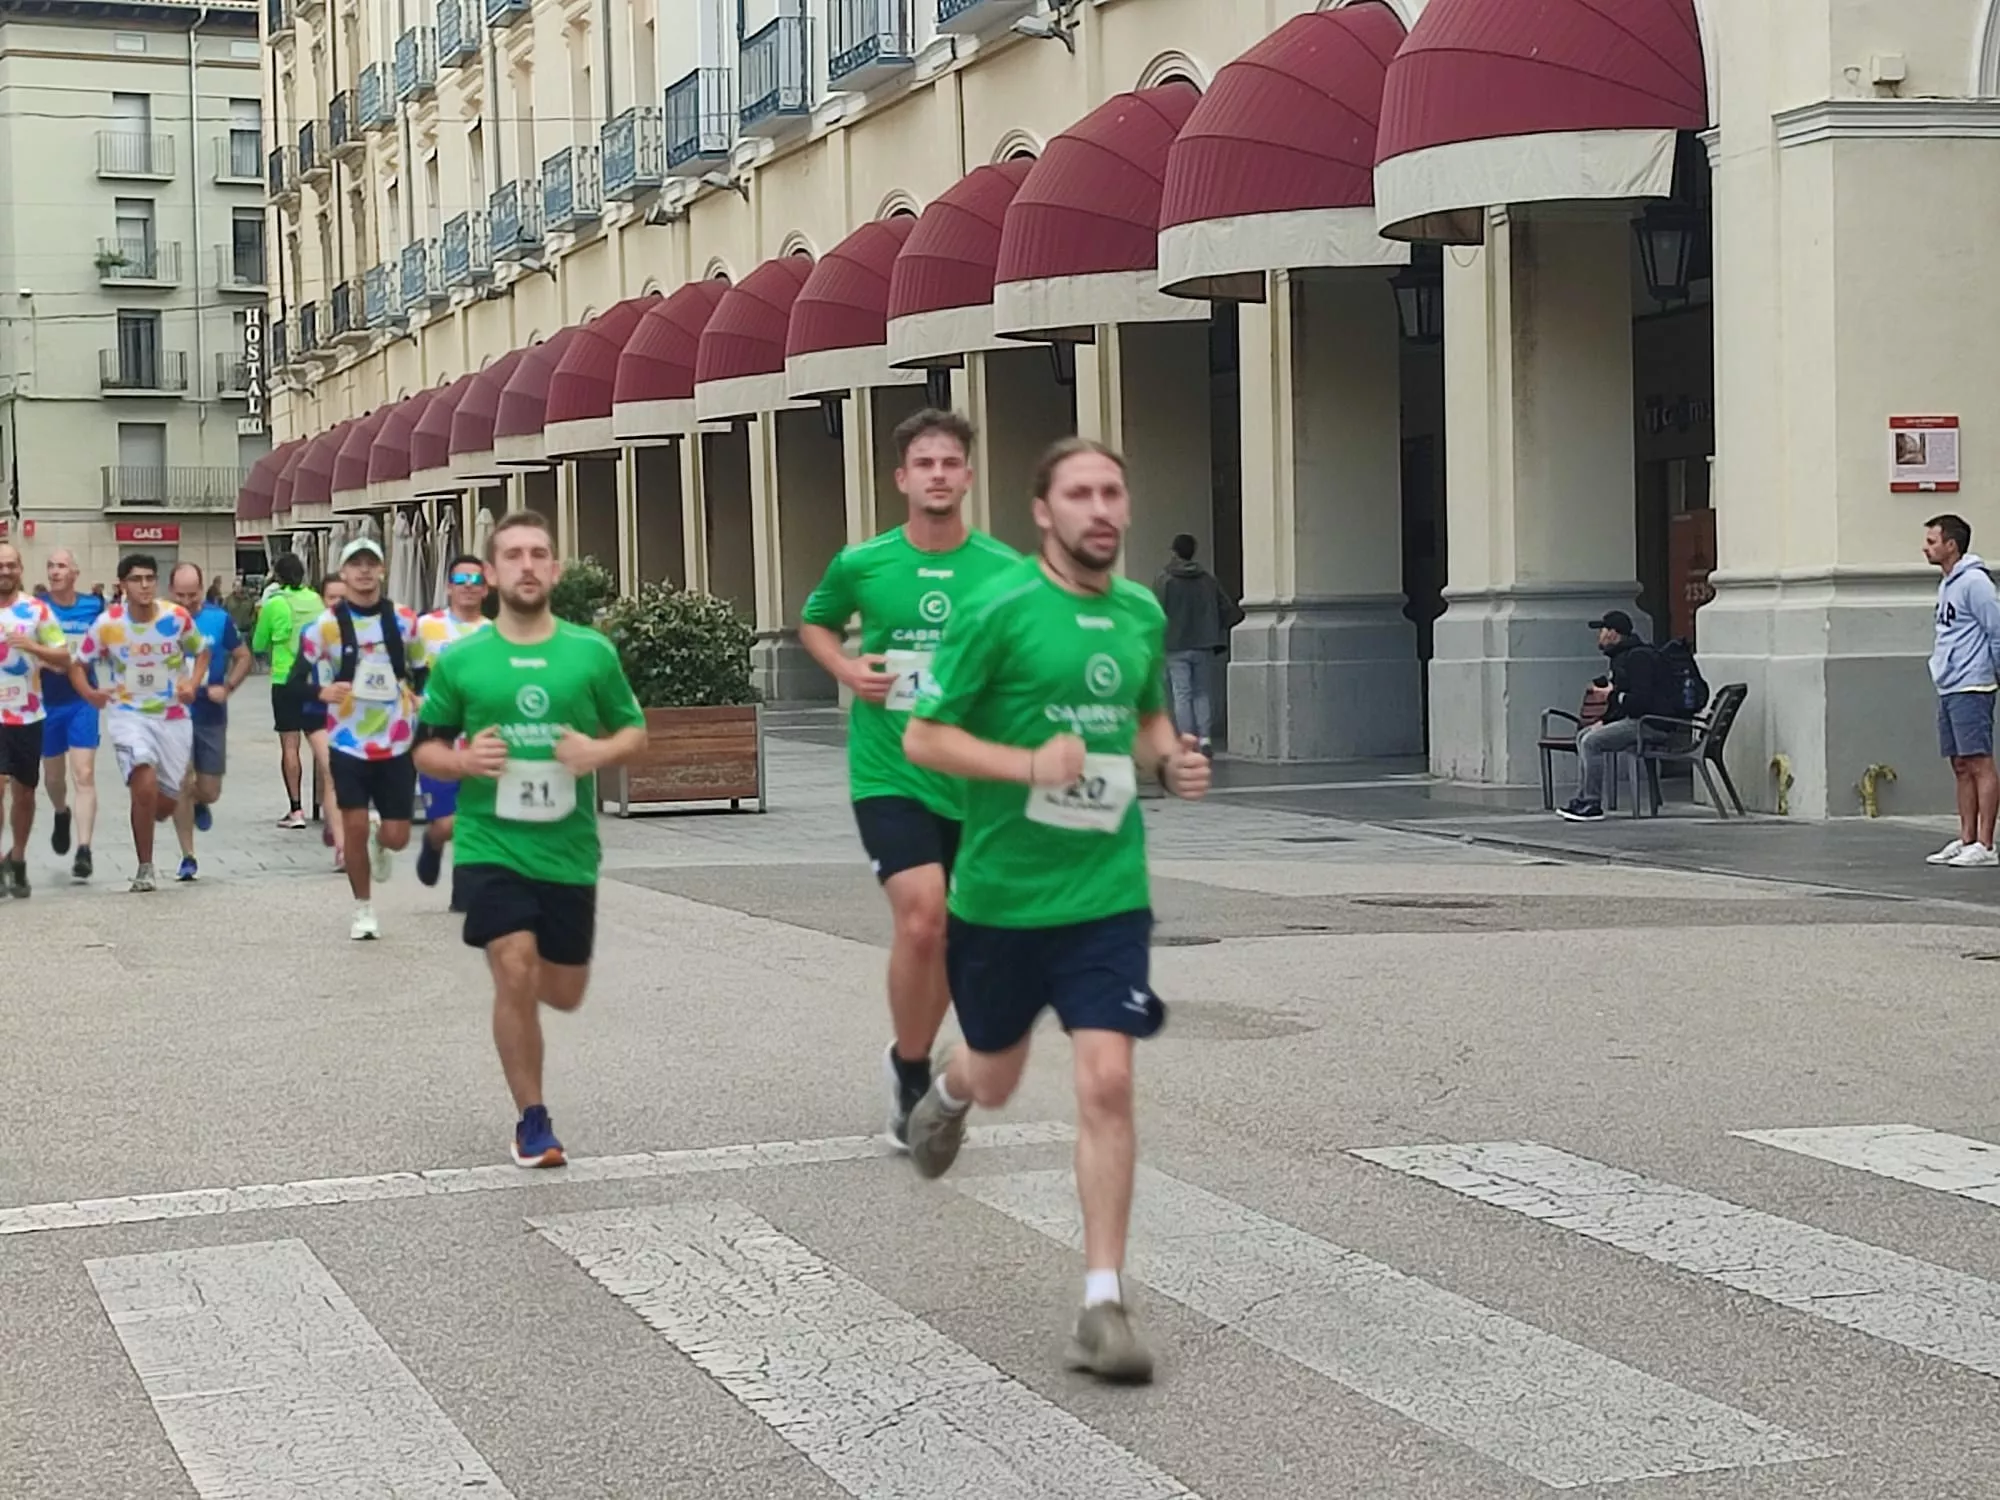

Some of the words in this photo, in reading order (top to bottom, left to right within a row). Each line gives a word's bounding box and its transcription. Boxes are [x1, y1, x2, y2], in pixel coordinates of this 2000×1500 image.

[245, 307, 262, 414] HOSTAL
[132, 527, 163, 539] GAES
[519, 780, 551, 802] 21
